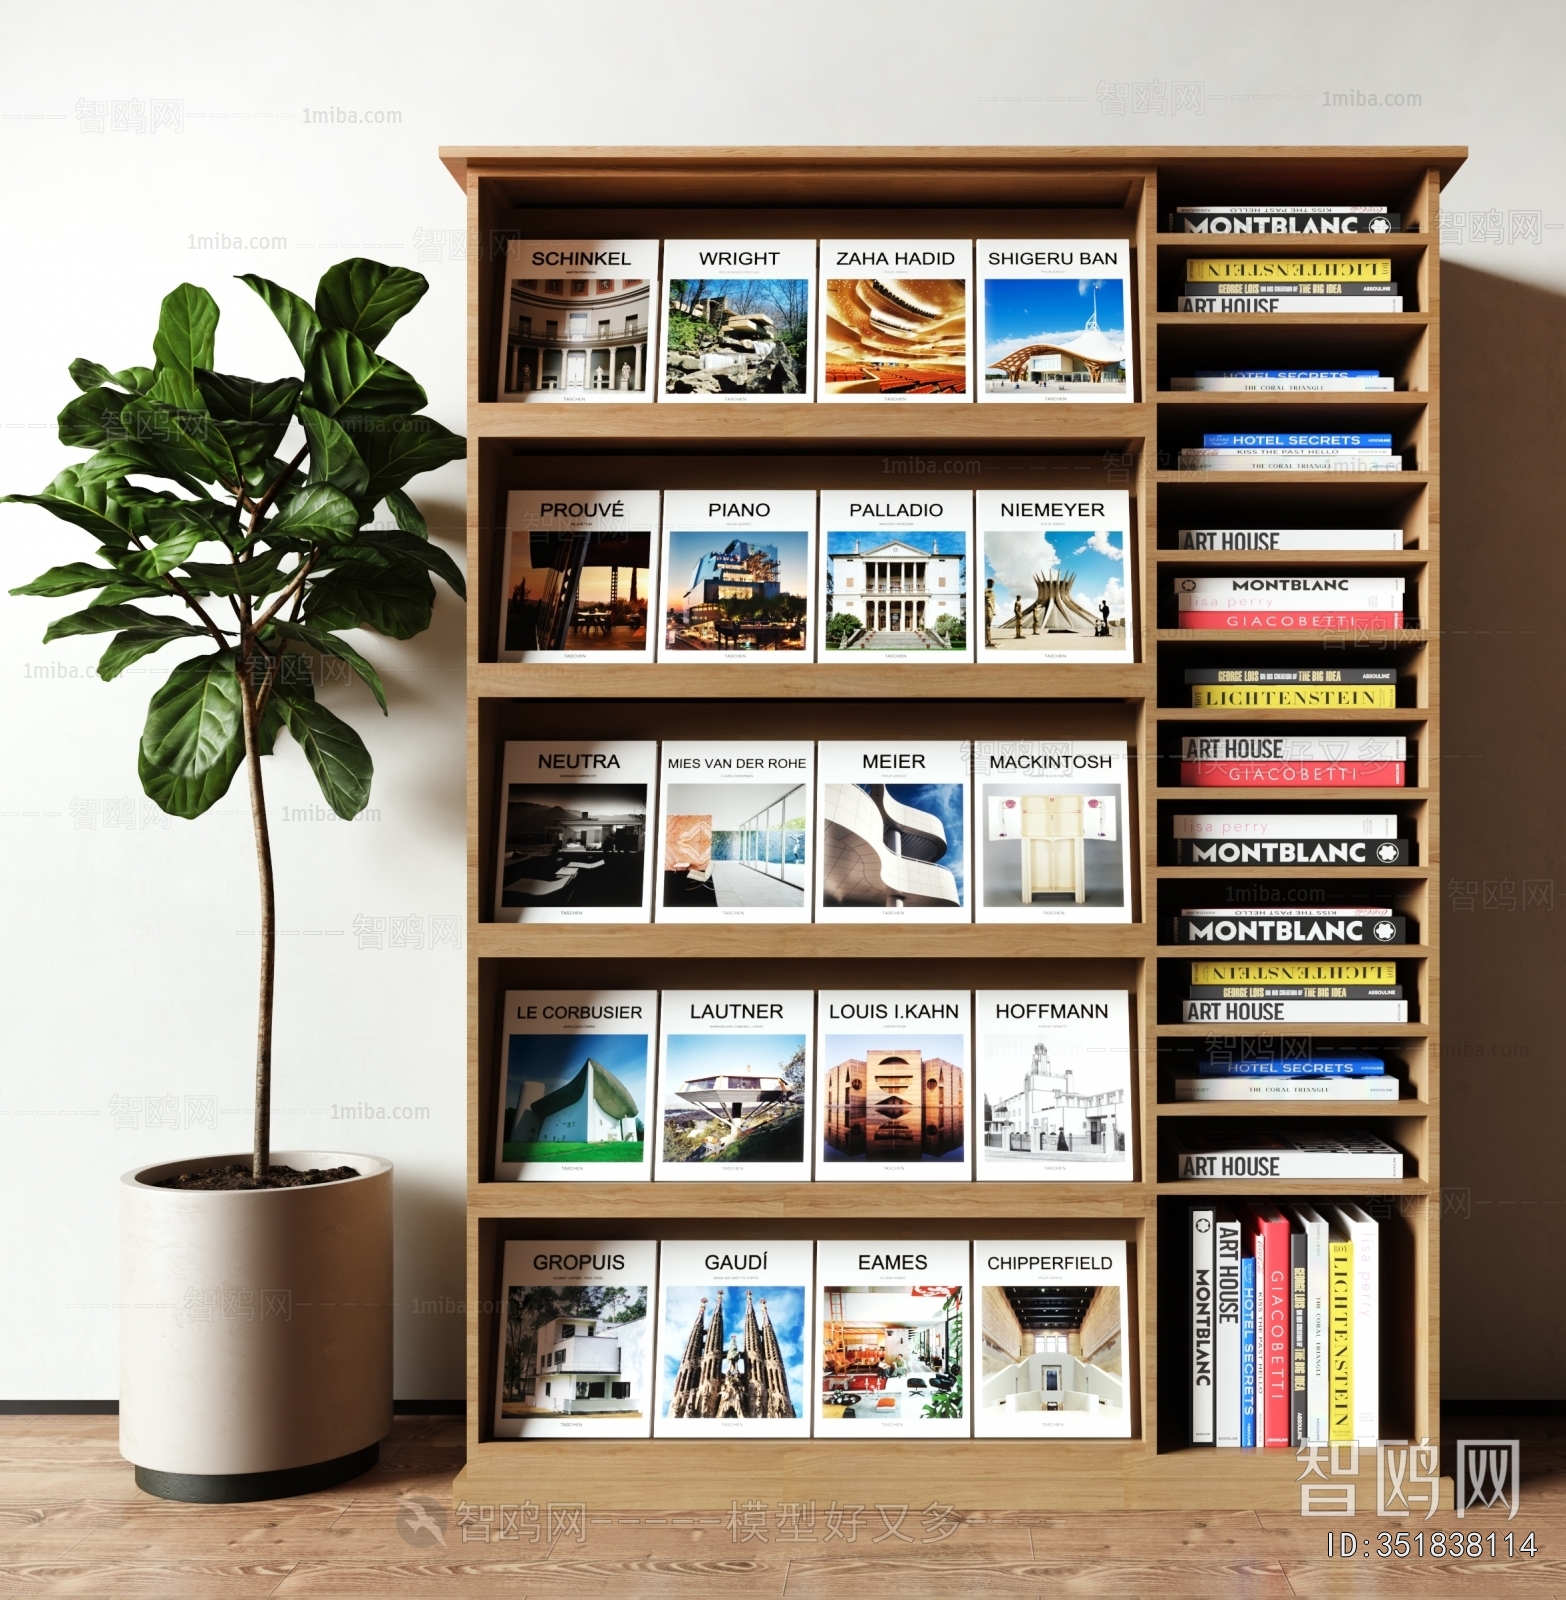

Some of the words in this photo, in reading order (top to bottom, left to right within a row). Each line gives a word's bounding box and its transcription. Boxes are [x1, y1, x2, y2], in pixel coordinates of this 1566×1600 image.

[1184, 217, 1358, 233] MONTBLANC
[532, 252, 632, 266] SCHINKEL
[699, 252, 780, 266] WRIGHT
[837, 252, 889, 265] ZAHA
[895, 252, 955, 265] HADID
[988, 252, 1073, 265] SHIGERU
[1080, 252, 1117, 265] BAN
[1207, 263, 1378, 276] LICHTENSTEIN
[1218, 284, 1243, 294] GEORGE
[1245, 284, 1259, 293] LOIS
[1299, 284, 1311, 293] THE
[1313, 284, 1324, 293] BIG
[1326, 284, 1342, 293] IDEA
[1183, 299, 1216, 313] ART
[1221, 299, 1279, 313] HOUSE
[1233, 436, 1284, 445] HOTEL
[1289, 436, 1360, 445] SECRETS
[540, 500, 624, 517] PROUVÉ
[709, 503, 770, 517] PIANO
[850, 503, 943, 517] PALLADIO
[1001, 503, 1105, 517] NIEMEYER
[1183, 532, 1217, 550] ART
[1222, 532, 1280, 550] HOUSE
[1232, 580, 1349, 591] MONTBLANC
[1189, 595, 1218, 606] lisa
[1228, 597, 1273, 608] perry
[1227, 616, 1355, 627] GIACOBETTI
[1218, 671, 1242, 681] GEORGE
[1244, 671, 1259, 681] LOIS
[1299, 671, 1310, 681] THE
[1312, 671, 1324, 681] BIG
[1326, 671, 1341, 681] IDEA
[1206, 692, 1375, 705] LICHTENSTEIN
[1187, 739, 1220, 758] ART
[1225, 739, 1283, 758] HOUSE
[538, 754, 620, 769] NEUTRA
[668, 758, 700, 769] MIES
[704, 758, 732, 769] VAN
[736, 758, 763, 769] DER
[768, 758, 806, 769] ROHE
[863, 754, 925, 769] MEIER
[991, 755, 1112, 769] MACKINTOSH
[1229, 768, 1356, 781] GIACOBETTI
[1184, 819, 1213, 832] lisa
[1222, 821, 1268, 835] perry
[1193, 843, 1366, 863] MONTBLANC
[1189, 921, 1362, 941] MONTBLANC
[1212, 966, 1383, 980] LICHTENSTEIN
[1223, 988, 1248, 998] GEORGE
[1250, 988, 1264, 997] LOIS
[1304, 988, 1316, 997] THE
[1318, 988, 1329, 997] BIG
[1331, 988, 1346, 997] IDEA
[517, 1006, 537, 1019] LE
[542, 1006, 642, 1019] CORBUSIER
[691, 1004, 783, 1019] LAUTNER
[830, 1004, 887, 1019] LOUIS
[894, 1004, 958, 1019] I.KAHN
[996, 1004, 1108, 1019] HOFFMANN
[1188, 1003, 1221, 1020] ART
[1226, 1003, 1284, 1020] HOUSE
[1228, 1064, 1278, 1072] HOTEL
[1283, 1064, 1353, 1072] SECRETS
[1183, 1157, 1217, 1176] ART
[1222, 1157, 1279, 1176] HOUSE
[1220, 1227, 1238, 1261] ART
[533, 1254, 625, 1270] GROPUIS
[705, 1251, 768, 1270] GAUDÍ
[859, 1255, 927, 1270] EAMES
[987, 1257, 1112, 1270] CHIPPERFIELD
[1295, 1268, 1305, 1292] GEORGE
[1219, 1266, 1238, 1324] HOUSE
[1295, 1294, 1305, 1308] LOIS
[1244, 1288, 1254, 1338] HOTEL
[1196, 1270, 1210, 1386] MONTBLANC
[1271, 1271, 1284, 1398] GIACOBETTI
[1334, 1258, 1348, 1426] LICHTENSTEIN
[1295, 1348, 1305, 1360] THE
[1295, 1362, 1305, 1373] BIG
[1244, 1344, 1253, 1415] SECRETS
[1295, 1376, 1305, 1391] IDEA
